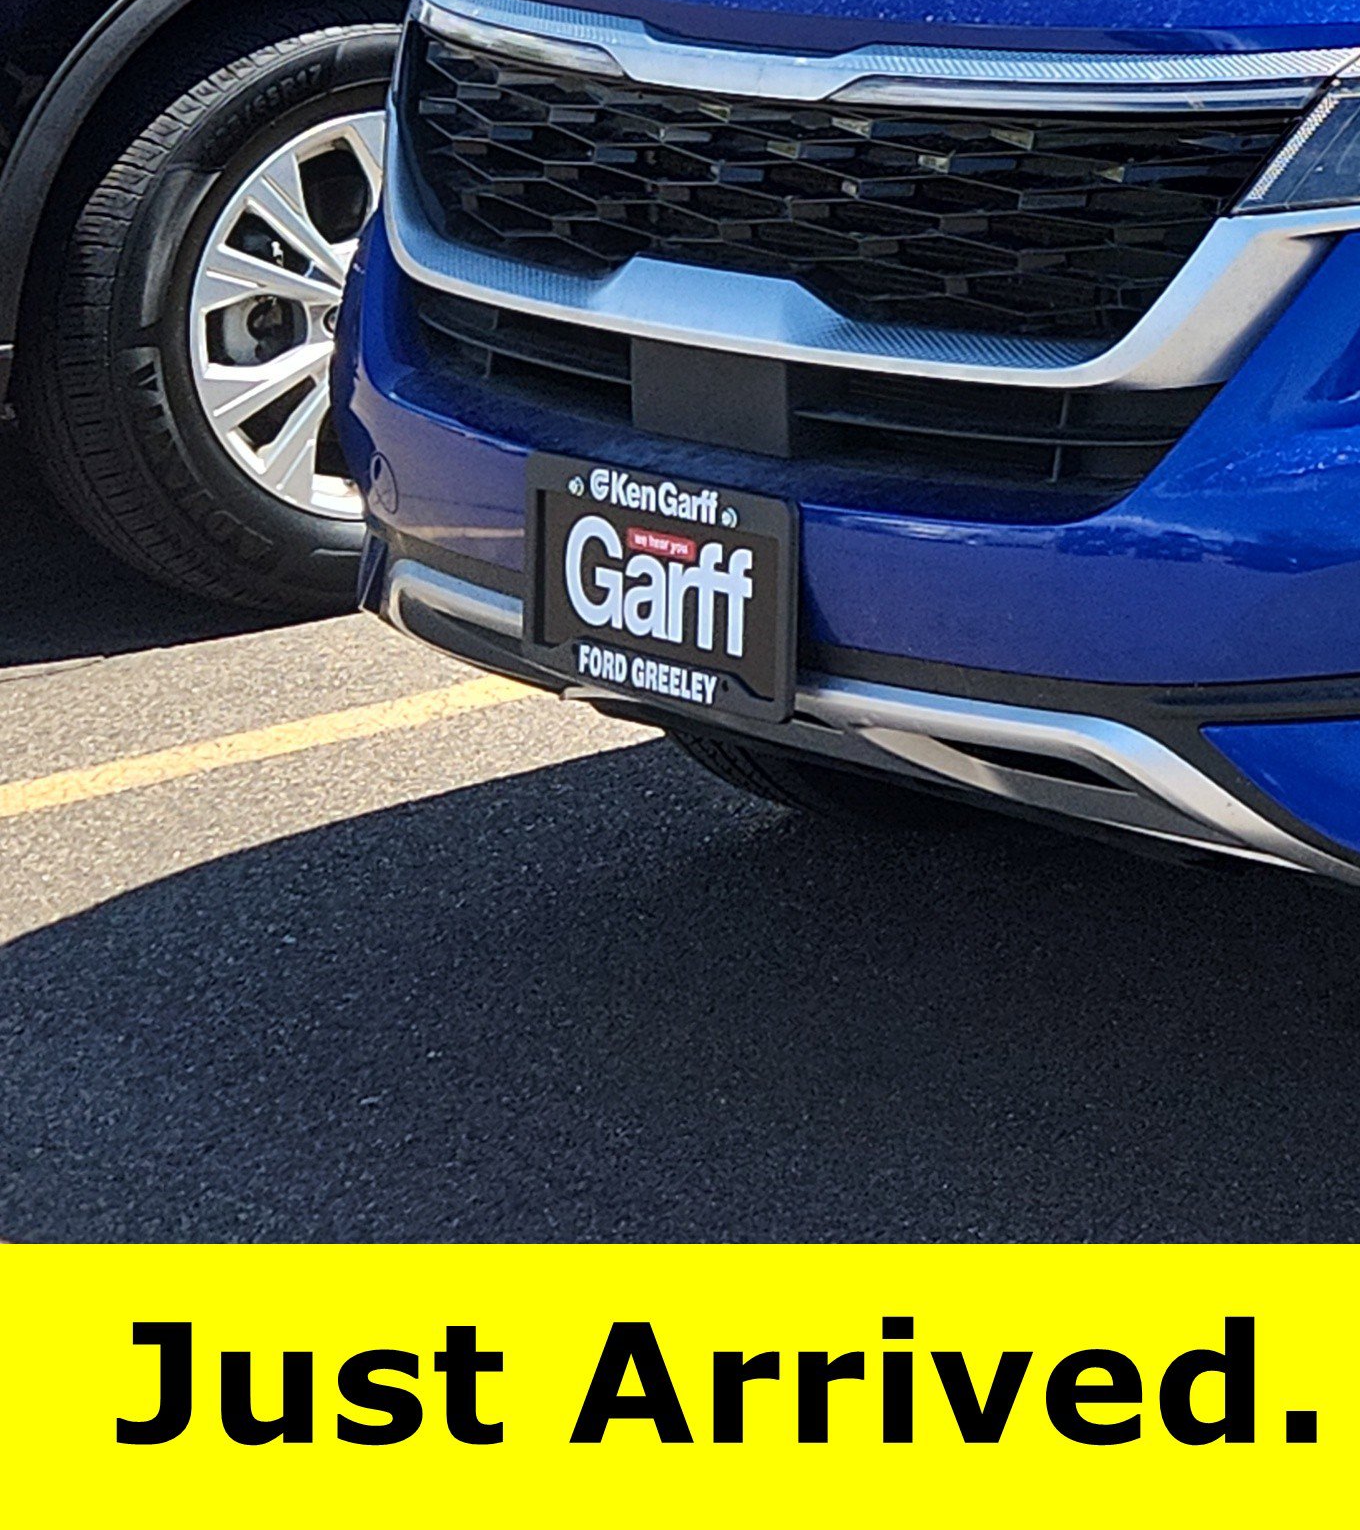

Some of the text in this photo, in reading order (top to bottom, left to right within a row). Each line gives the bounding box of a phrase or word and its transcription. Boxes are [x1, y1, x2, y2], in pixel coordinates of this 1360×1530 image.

[610, 471, 718, 524] Ken Garff
[565, 516, 752, 657] Garff
[578, 644, 717, 704] FORD GREELEY
